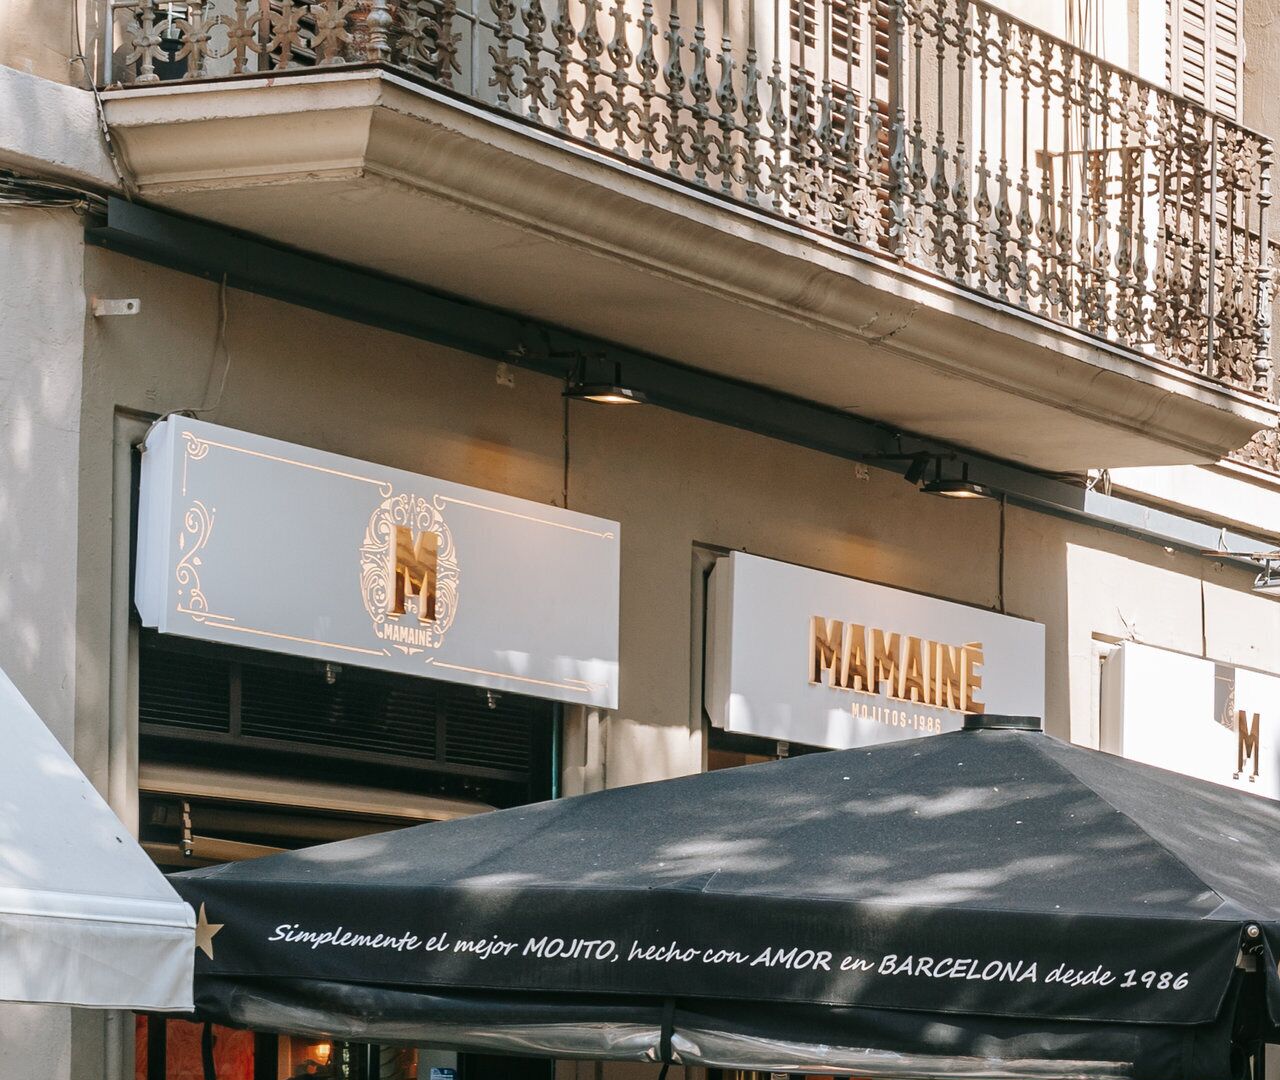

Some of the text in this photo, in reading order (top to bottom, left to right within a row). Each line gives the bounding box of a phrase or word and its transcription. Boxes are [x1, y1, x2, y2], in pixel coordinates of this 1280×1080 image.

[386, 524, 438, 622] M
[808, 615, 985, 714] MAMAINÉ
[1233, 709, 1260, 782] M
[268, 923, 1189, 991] Simplemente el mejor MOJITO, hecho con AMOR en BARCELONA desde 1986
